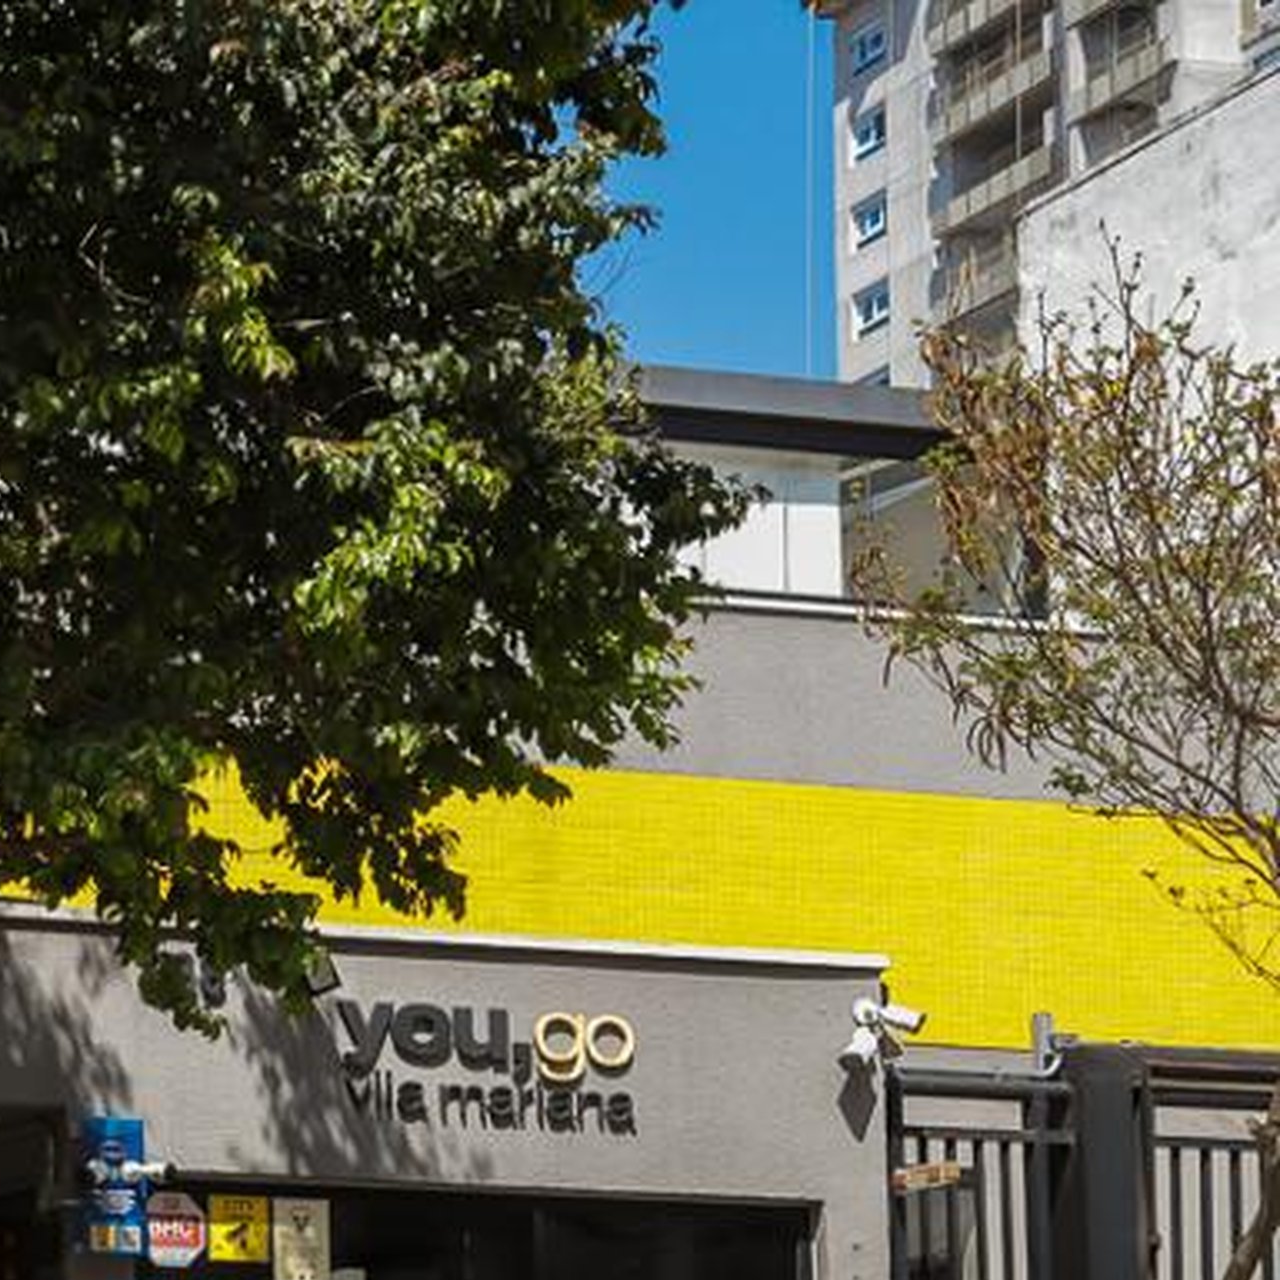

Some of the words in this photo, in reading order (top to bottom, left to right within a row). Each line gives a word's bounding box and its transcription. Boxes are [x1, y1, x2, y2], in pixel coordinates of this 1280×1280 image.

[336, 1000, 637, 1084] you,go
[343, 1071, 429, 1125] vila
[439, 1081, 637, 1136] mariana
